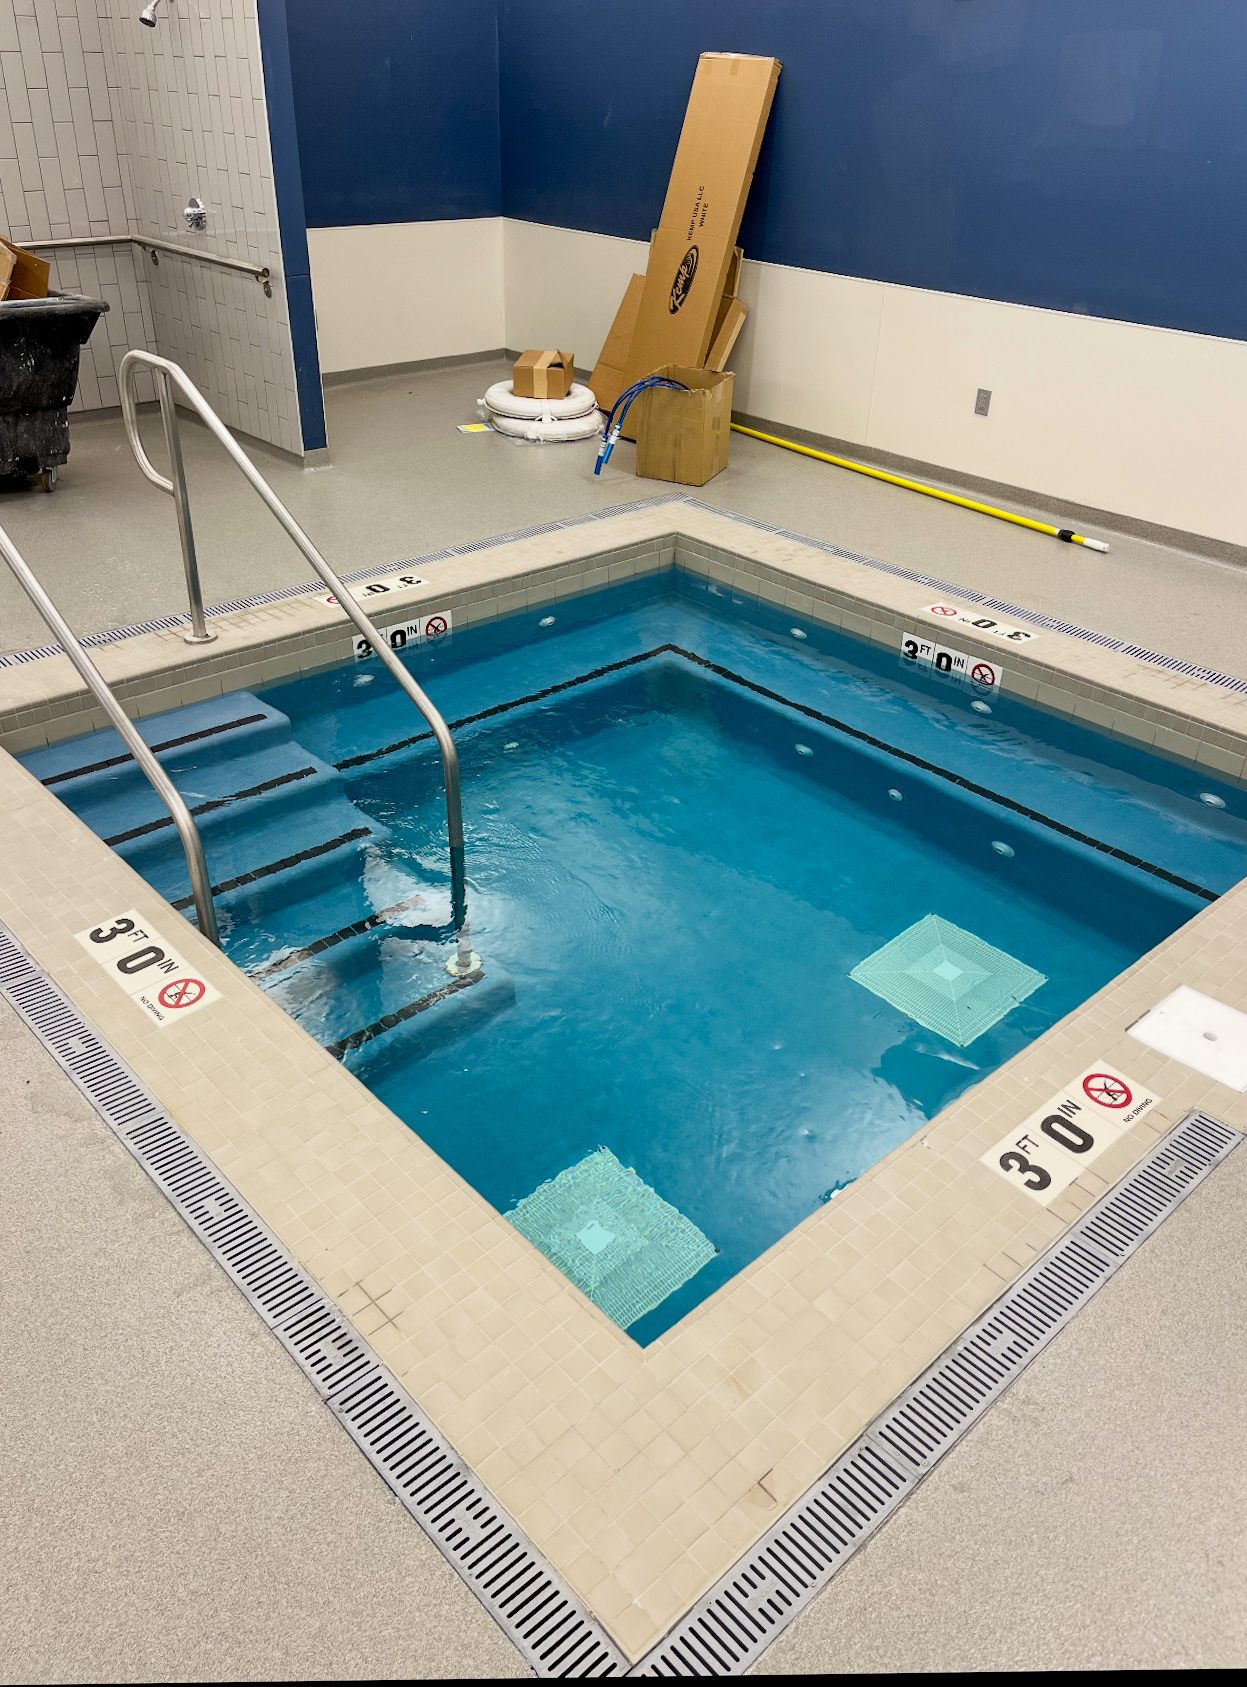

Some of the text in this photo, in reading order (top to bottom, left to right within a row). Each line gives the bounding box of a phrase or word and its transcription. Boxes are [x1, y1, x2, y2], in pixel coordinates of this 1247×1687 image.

[686, 219, 695, 240] KEMP
[692, 201, 700, 218] USA
[699, 203, 709, 227] WHITE
[670, 264, 690, 311] Kemp
[366, 584, 390, 592] 0
[399, 576, 421, 585] 3
[972, 618, 997, 629] 0
[1007, 631, 1031, 641] 3
[357, 624, 418, 659] 3 0 IN
[903, 639, 965, 672] 3 FT 0 IN
[89, 918, 180, 975] 3 FT 0 IN
[147, 1003, 164, 1021] DIVING
[1123, 1097, 1153, 1124] NO DIVING
[999, 1099, 1095, 1191] 3 FT 0 IN
